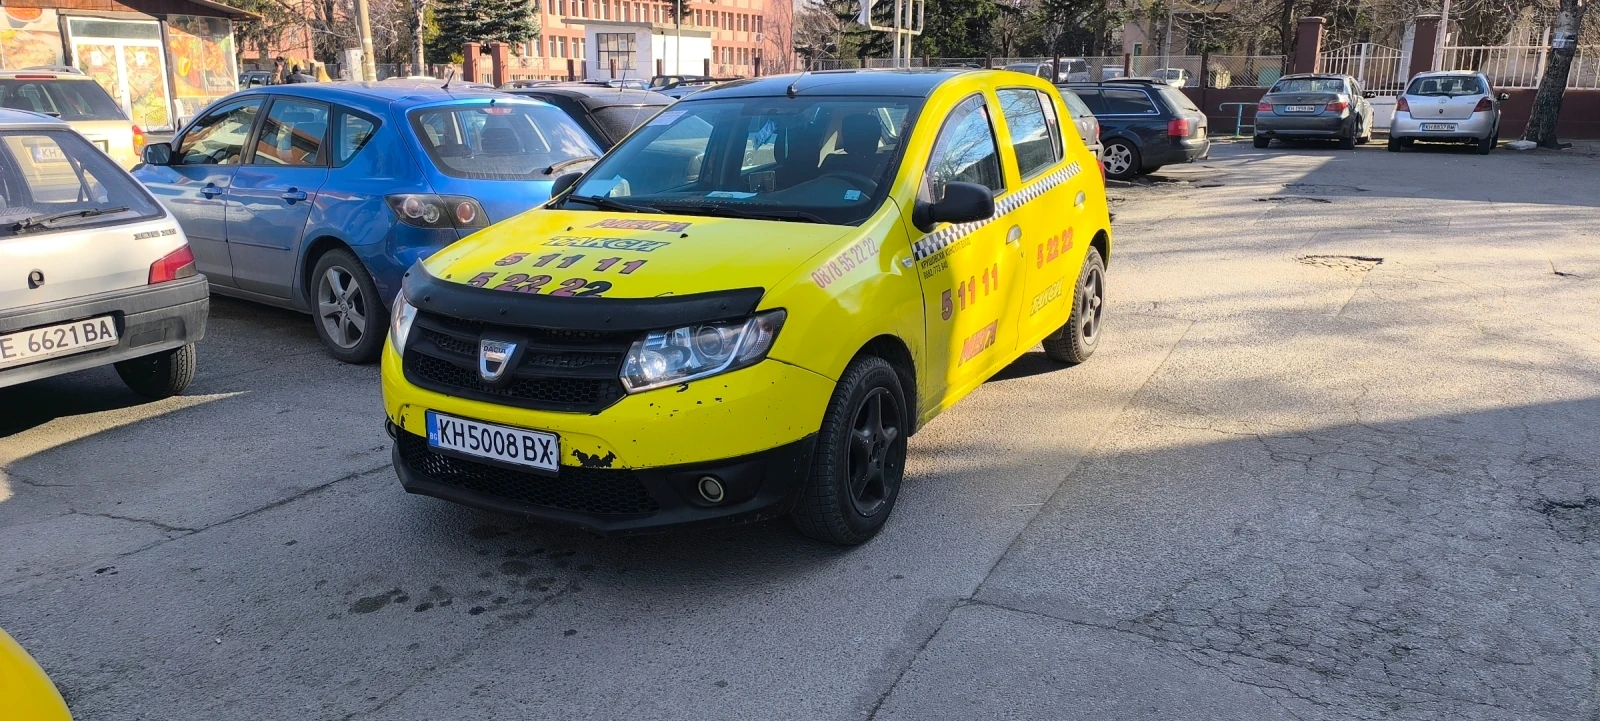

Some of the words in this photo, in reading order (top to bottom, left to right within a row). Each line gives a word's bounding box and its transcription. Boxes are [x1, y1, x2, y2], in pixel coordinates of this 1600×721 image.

[541, 235, 671, 252] ТАКСИ
[1037, 243, 1044, 269] 5
[1046, 235, 1059, 264] 22
[1061, 226, 1073, 254] 22
[494, 252, 531, 266] 5
[532, 253, 586, 268] 11
[593, 257, 648, 274] 11
[811, 261, 843, 289] 0878
[837, 252, 856, 272] 55
[850, 244, 868, 264] 22
[863, 237, 879, 256] 22
[467, 272, 498, 288] 5
[493, 273, 553, 294] 22
[550, 278, 613, 298] 22
[941, 288, 953, 321] 5
[958, 275, 976, 311] 11
[982, 263, 998, 296] 11
[483, 345, 506, 353] DACIA
